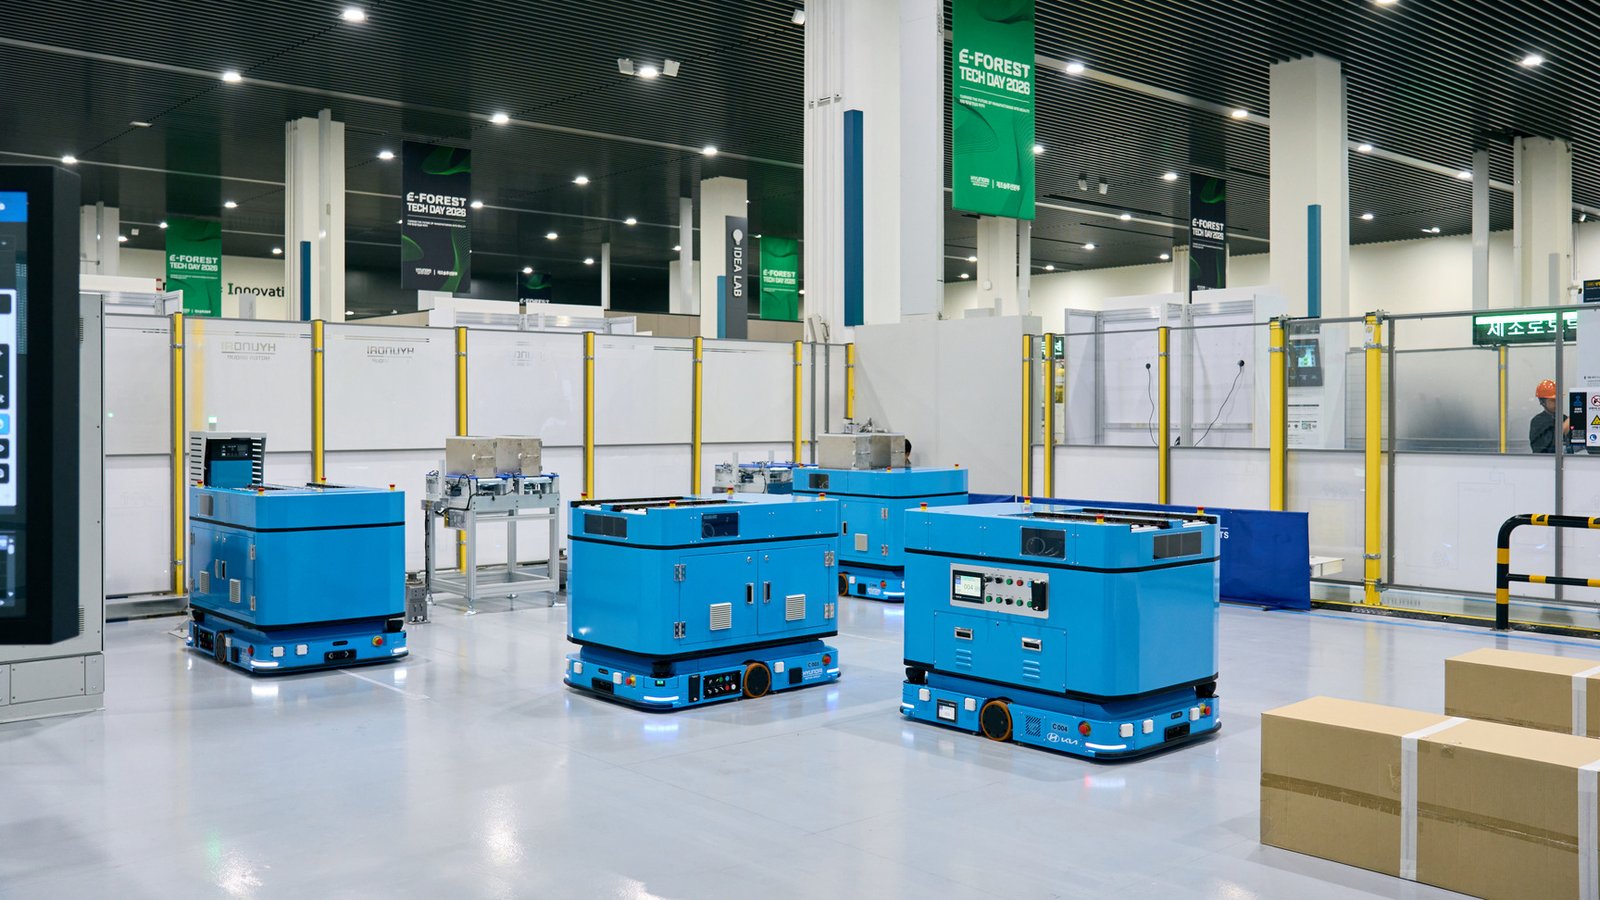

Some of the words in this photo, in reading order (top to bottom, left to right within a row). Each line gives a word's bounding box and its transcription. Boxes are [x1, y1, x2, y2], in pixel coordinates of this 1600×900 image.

[959, 48, 1030, 78] E-FOREST
[959, 65, 985, 85] TECH
[986, 72, 1006, 89] DAY
[1006, 77, 1030, 95] 2026
[406, 191, 467, 207] E-FOREST
[406, 202, 429, 213] TECH
[429, 205, 446, 215] DAY
[445, 206, 467, 217] 2026
[1192, 218, 1224, 231] E-FOREST
[1192, 227, 1204, 237] TECH
[1204, 229, 1213, 239] DAY
[1212, 230, 1224, 240] 2026
[169, 254, 218, 264] E-FOREST
[170, 261, 187, 271] TECH
[188, 263, 201, 271] DAY
[200, 264, 218, 272] 2026
[733, 247, 742, 272] IDEA
[763, 269, 796, 278] E-FOREST
[228, 282, 285, 298] Innovati
[733, 275, 742, 297] LAB
